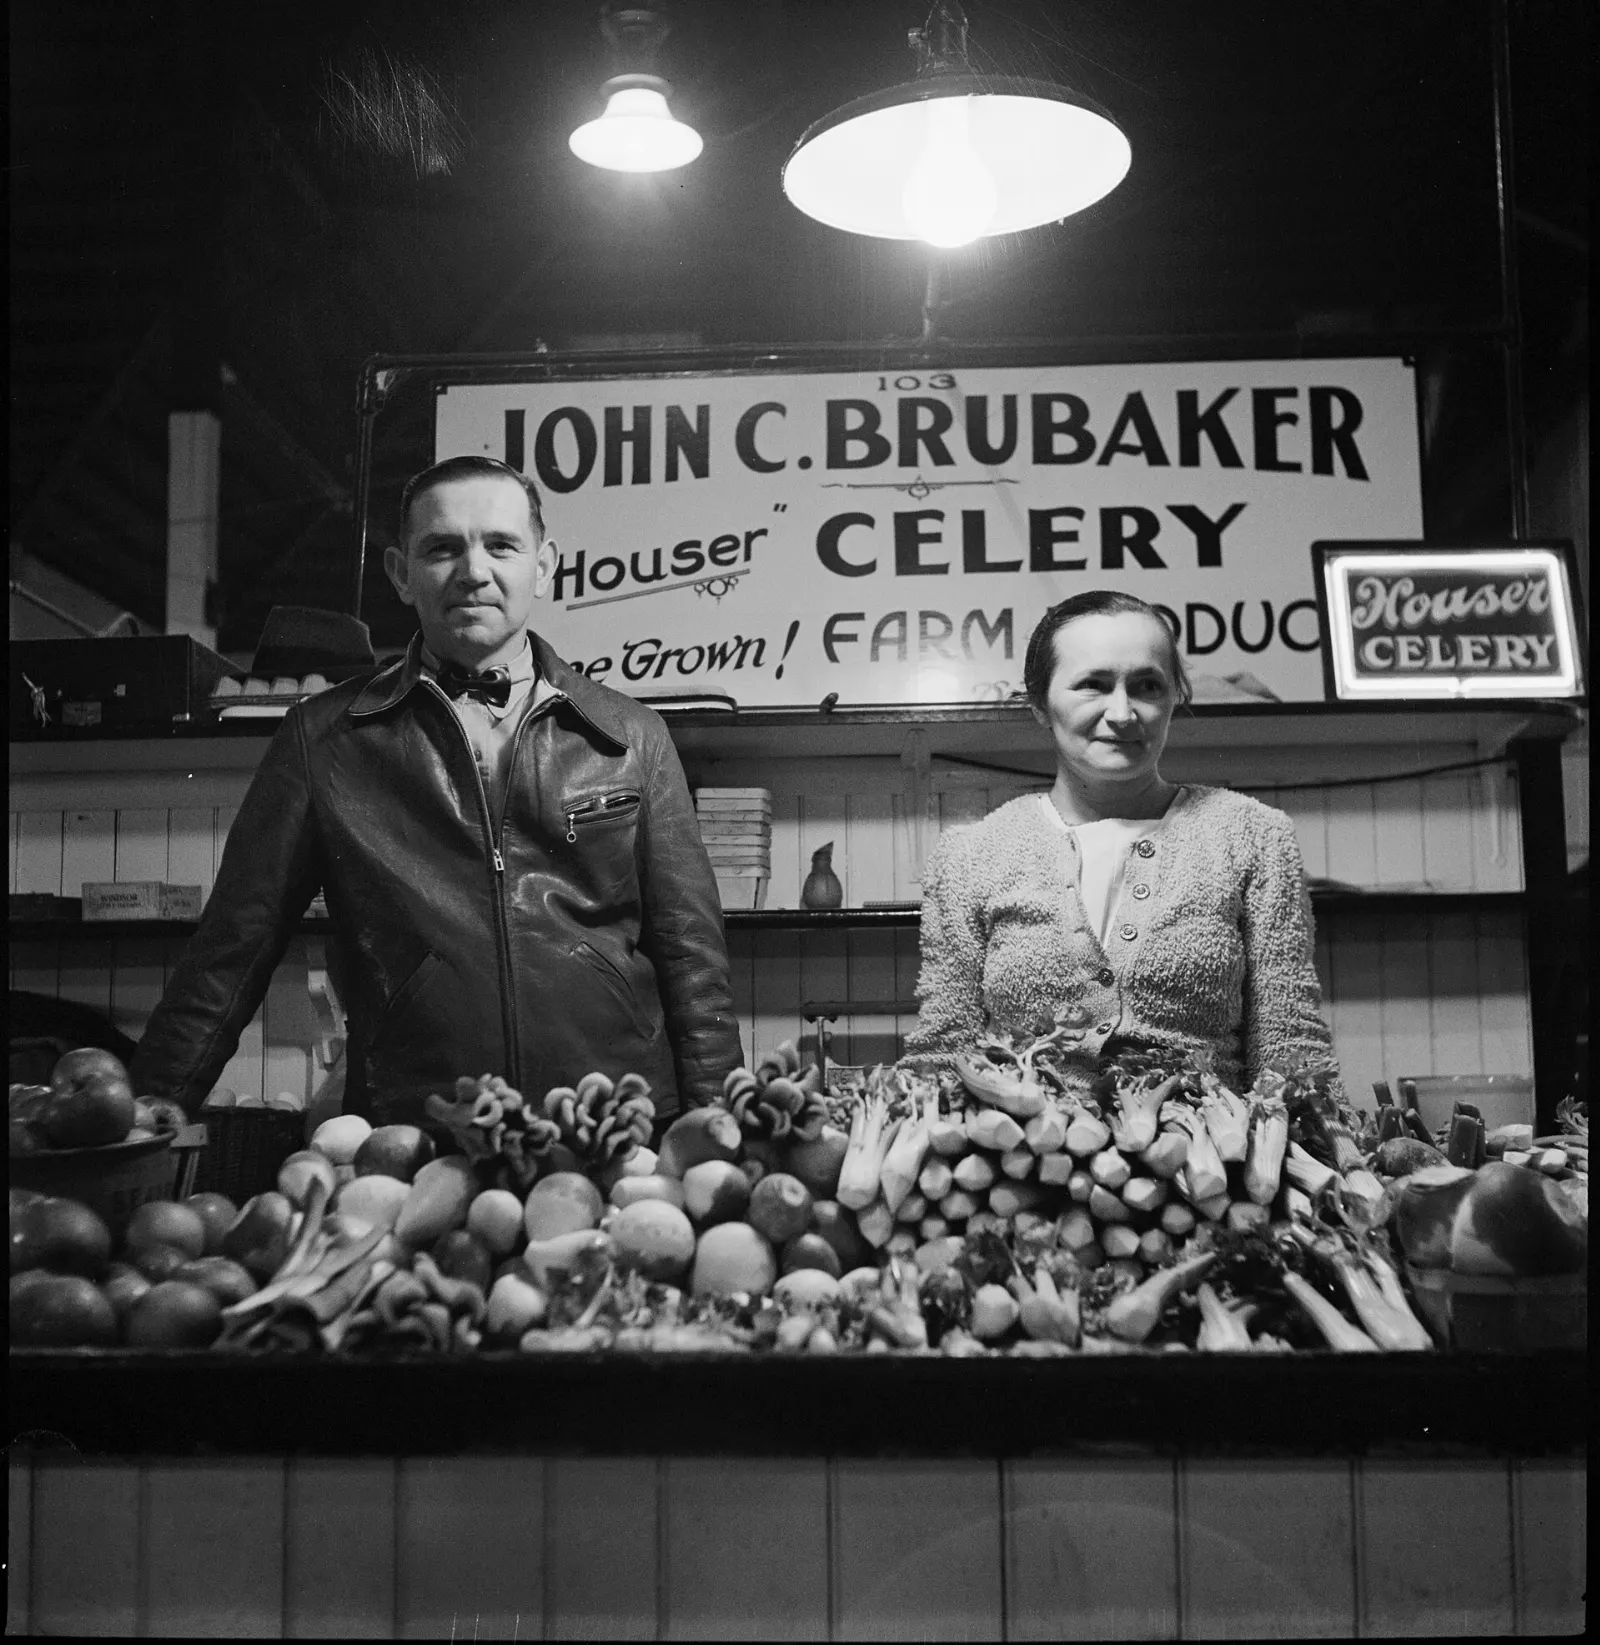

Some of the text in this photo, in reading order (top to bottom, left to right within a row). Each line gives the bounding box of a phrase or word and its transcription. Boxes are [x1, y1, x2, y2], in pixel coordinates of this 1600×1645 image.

[878, 373, 956, 391] 103
[735, 401, 813, 473] C.
[825, 386, 1370, 482] BRUBAKER
[816, 502, 1248, 577] CELERY
[1352, 576, 1551, 629] Houser
[822, 609, 1015, 662] FARM
[1361, 635, 1554, 668] CELERY
